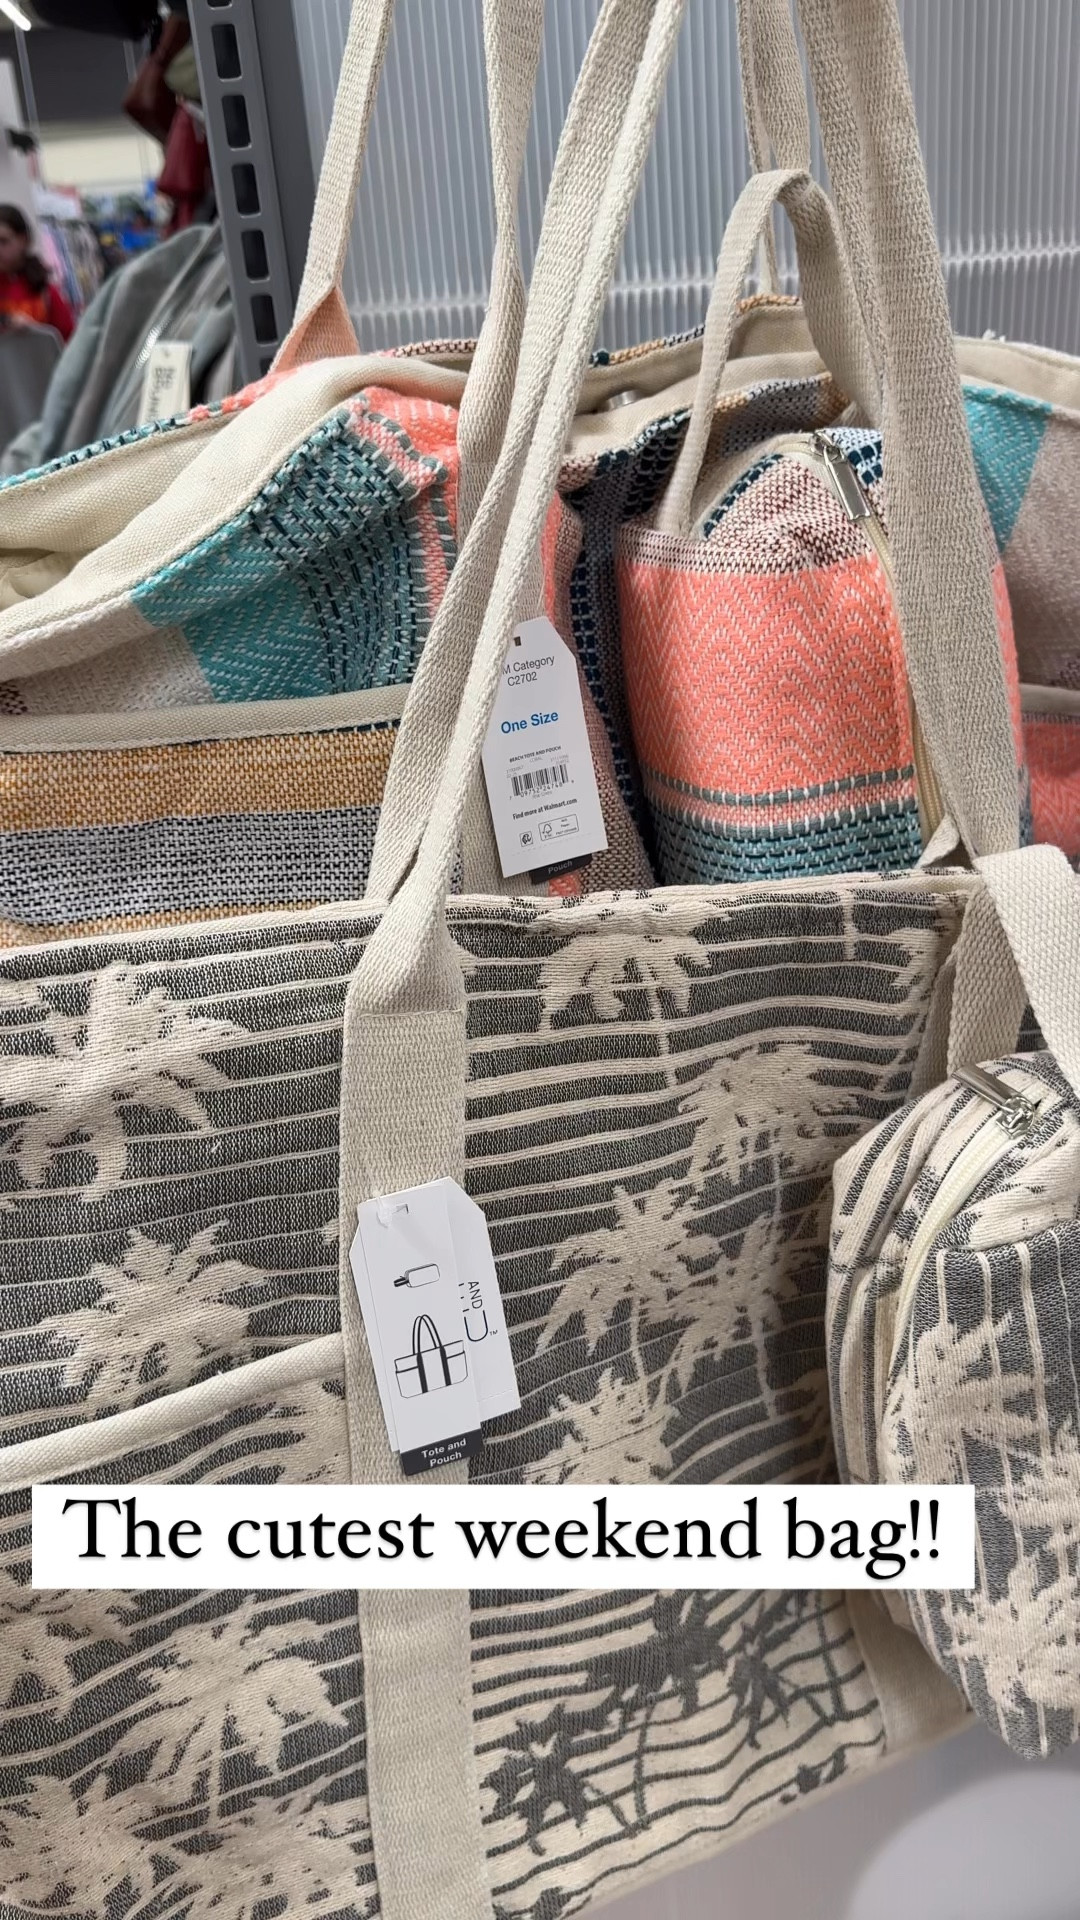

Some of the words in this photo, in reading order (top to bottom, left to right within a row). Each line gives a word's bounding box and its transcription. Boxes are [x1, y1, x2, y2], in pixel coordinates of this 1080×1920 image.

[513, 656, 555, 673] Category
[507, 672, 538, 686] C2702
[501, 719, 528, 734] One
[531, 712, 559, 726] Size
[546, 745, 561, 753] POUCH
[512, 812, 524, 820] Find
[543, 799, 578, 811] Walmart.com
[547, 861, 573, 874] Pouch
[467, 1281, 484, 1309] AND
[421, 1446, 445, 1458] Tote
[447, 1438, 467, 1450] and
[429, 1451, 462, 1467] Pouch
